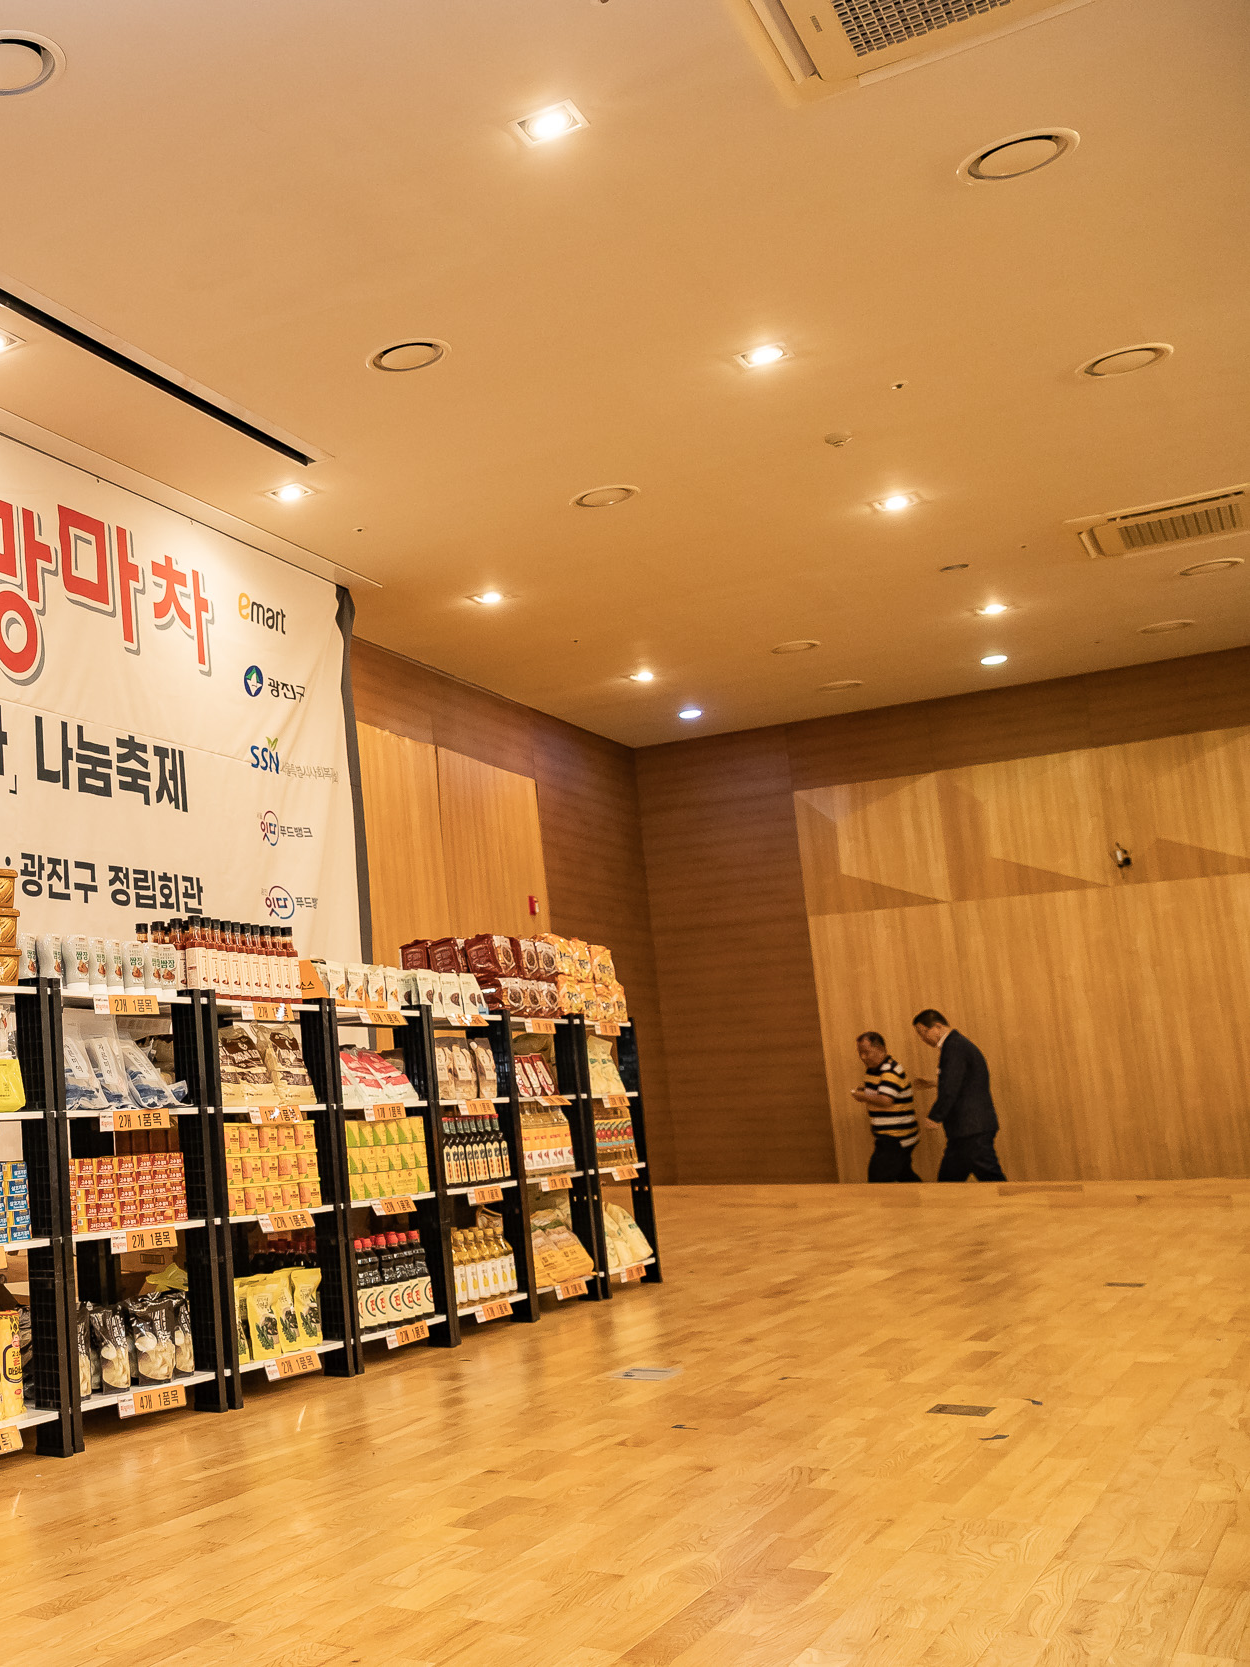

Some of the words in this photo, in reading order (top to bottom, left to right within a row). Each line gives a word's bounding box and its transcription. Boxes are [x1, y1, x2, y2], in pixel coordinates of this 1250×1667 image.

[238, 592, 287, 635] emart
[267, 677, 306, 703] 광진구
[34, 715, 189, 813] 나눔축제
[251, 745, 280, 775] SSN
[21, 852, 98, 904] 광진구
[108, 865, 204, 914] 정립회관
[132, 999, 153, 1013] 1품목
[118, 1114, 132, 1129] 2개
[138, 1112, 162, 1129] 1품목
[150, 1231, 171, 1247] 1품목
[139, 1394, 153, 1410] 4개
[157, 1389, 179, 1407] 1품목
